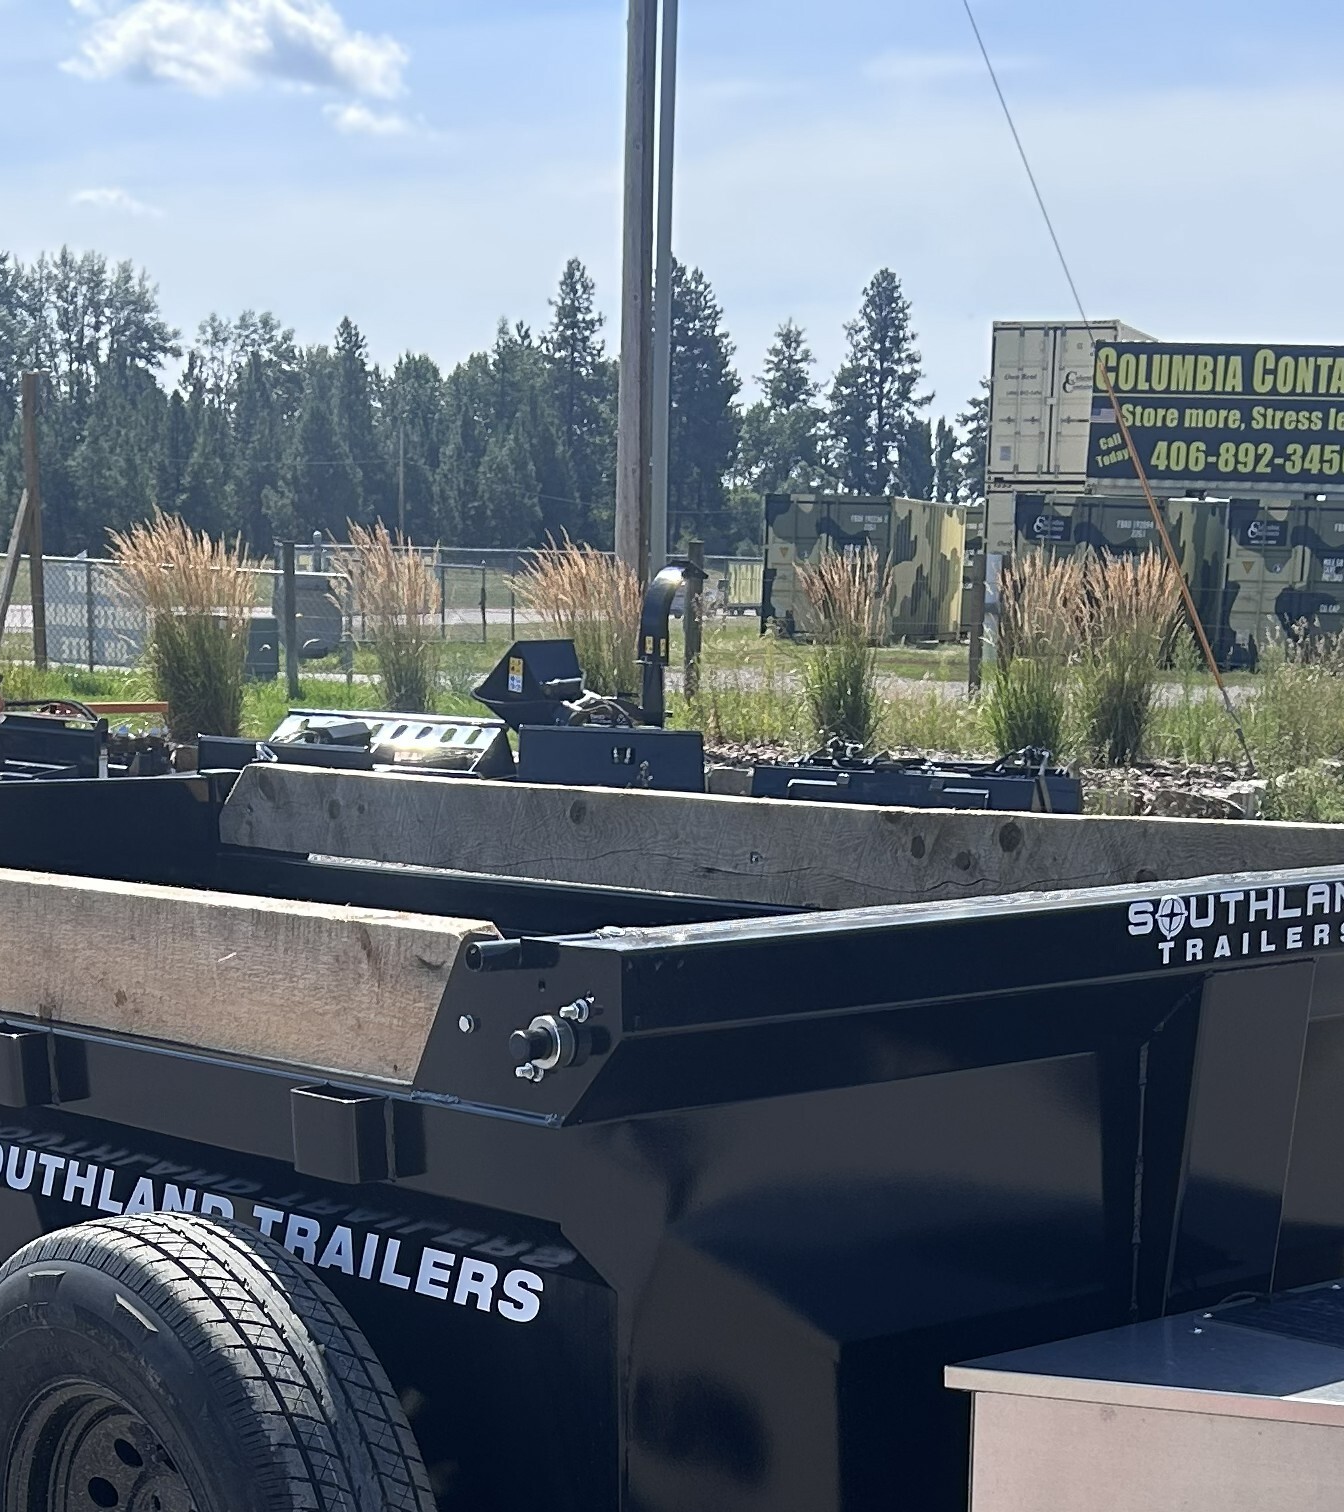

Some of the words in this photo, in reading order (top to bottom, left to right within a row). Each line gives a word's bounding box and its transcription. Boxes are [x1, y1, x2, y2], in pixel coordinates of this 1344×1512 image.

[1095, 346, 1243, 391] COLUMBIA
[1121, 404, 1179, 427] Store
[1184, 411, 1246, 430] more,
[1252, 406, 1323, 430] Stress
[1099, 432, 1122, 450] Call
[253, 1205, 545, 1323] TRAILERS
